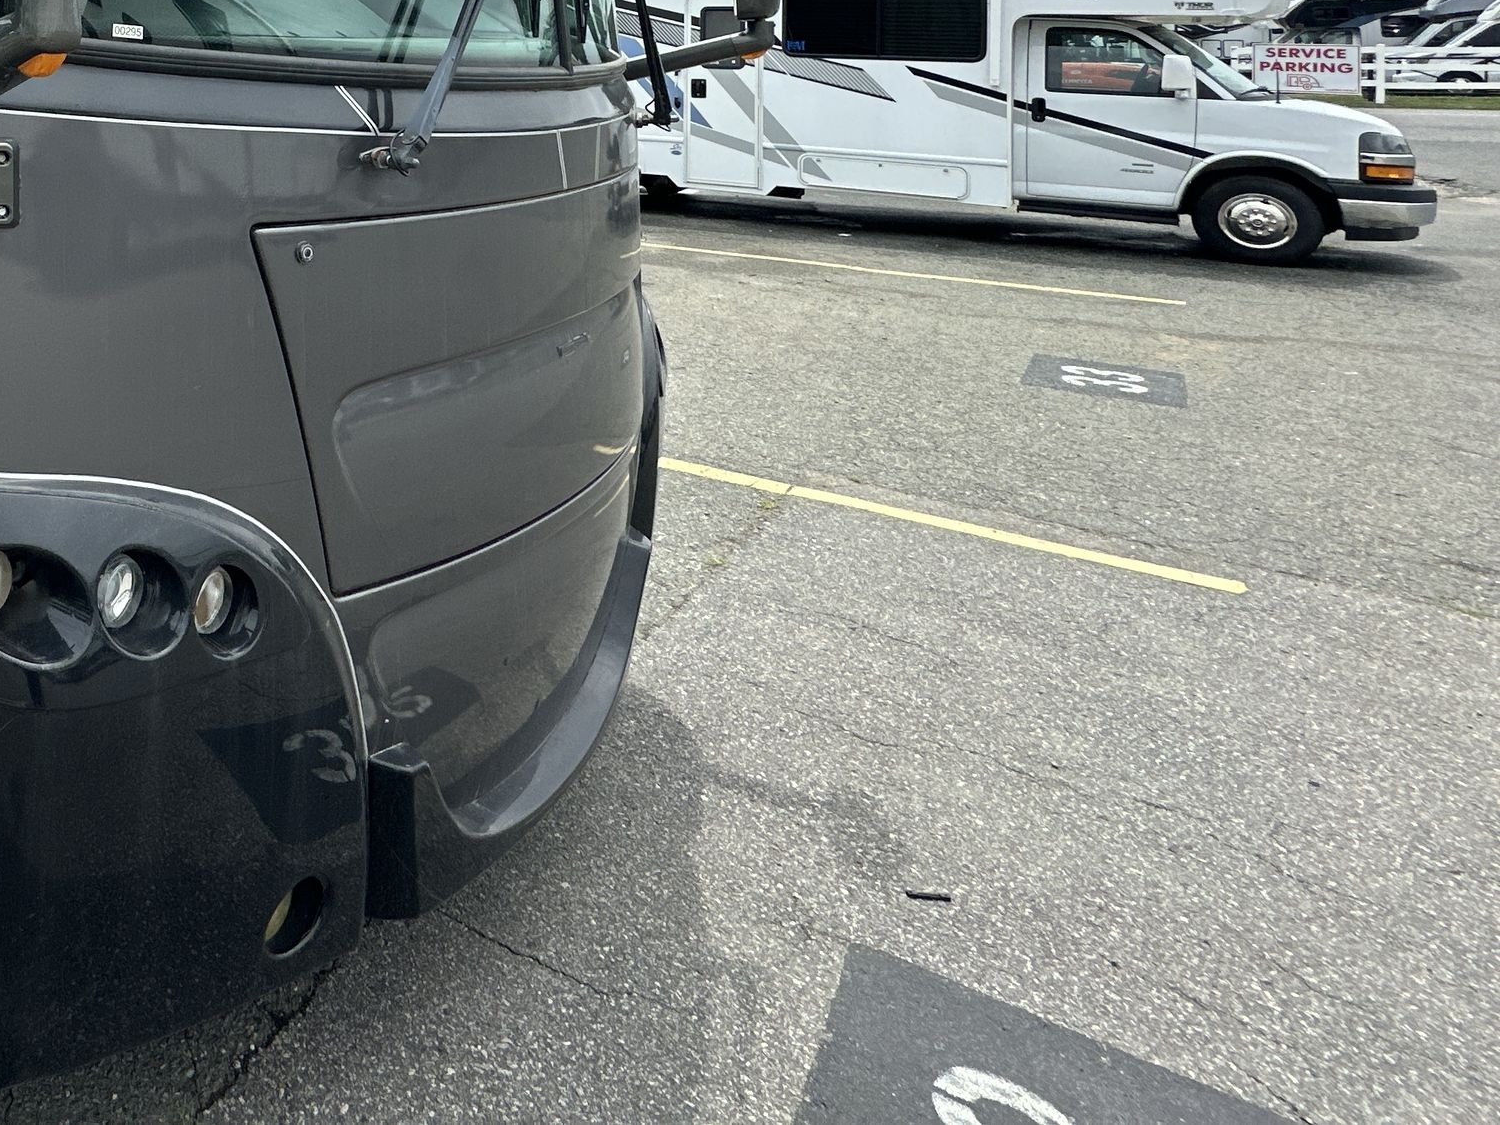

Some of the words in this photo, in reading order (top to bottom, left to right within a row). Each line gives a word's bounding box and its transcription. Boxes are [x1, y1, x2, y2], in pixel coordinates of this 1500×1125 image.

[114, 25, 142, 37] 00295
[1265, 47, 1347, 59] SERVICE
[1260, 61, 1353, 74] PARKING
